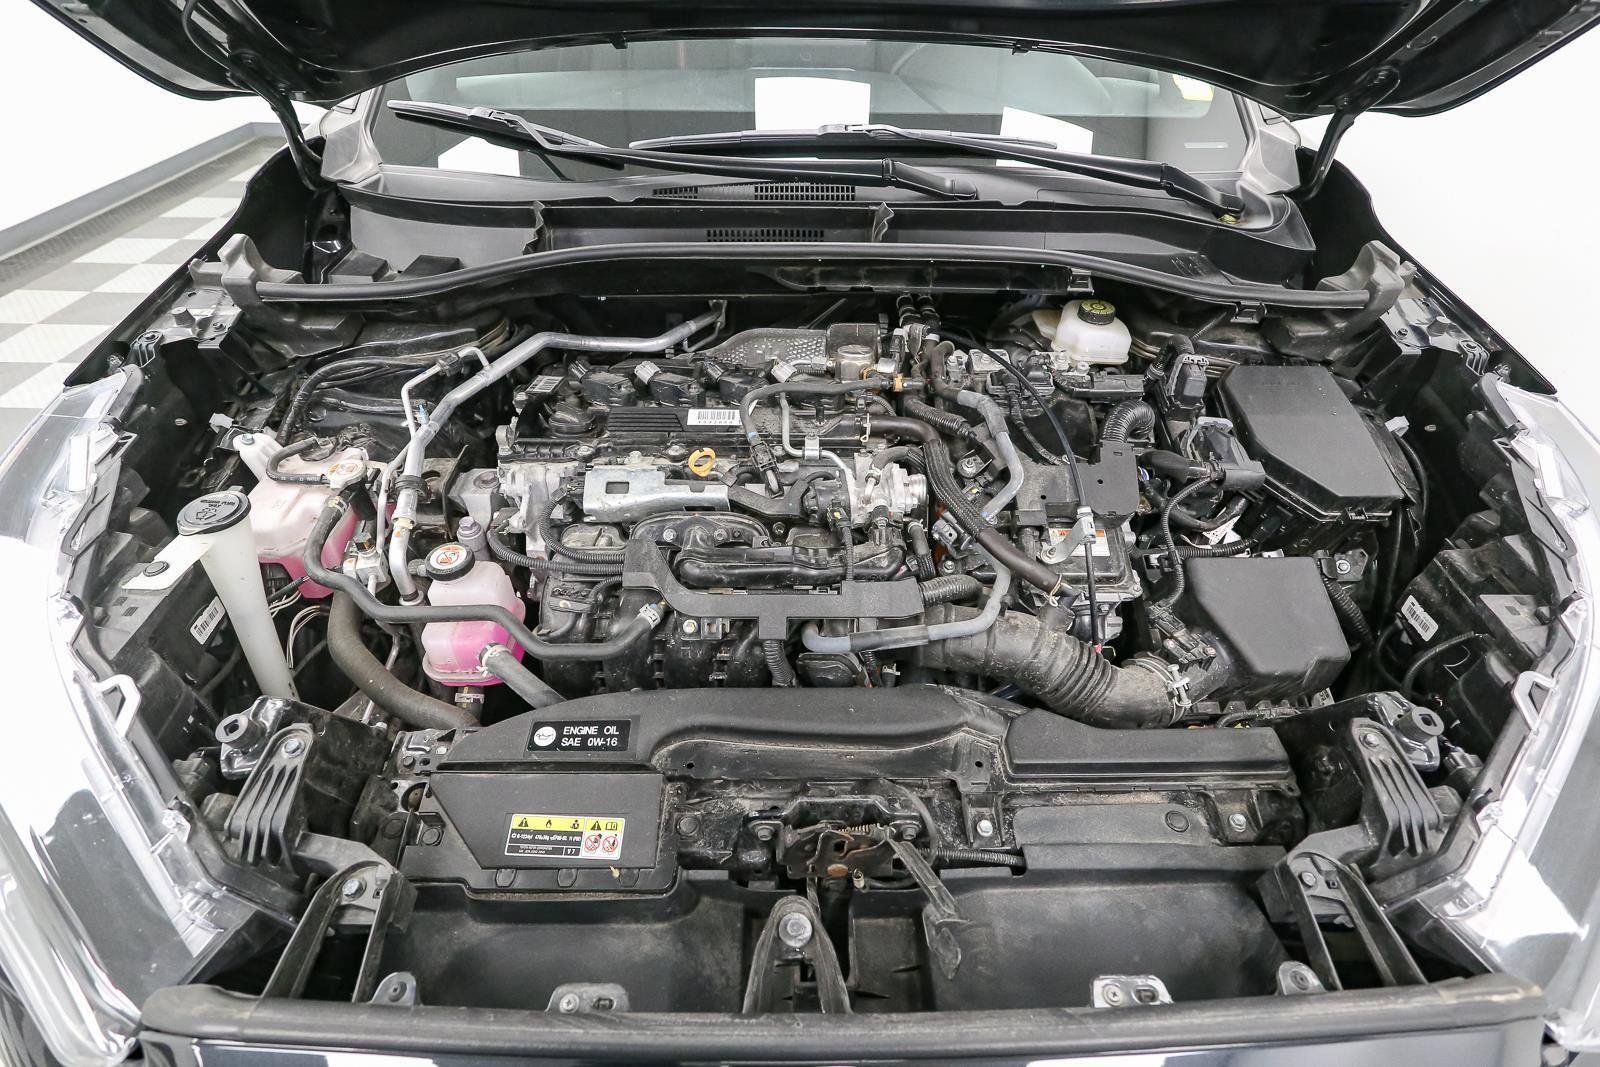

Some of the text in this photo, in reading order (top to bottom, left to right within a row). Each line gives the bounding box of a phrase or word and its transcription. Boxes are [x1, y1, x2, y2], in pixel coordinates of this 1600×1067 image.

[563, 725, 620, 735] ENGINE OIL
[560, 737, 618, 747] SAE 0W-16
